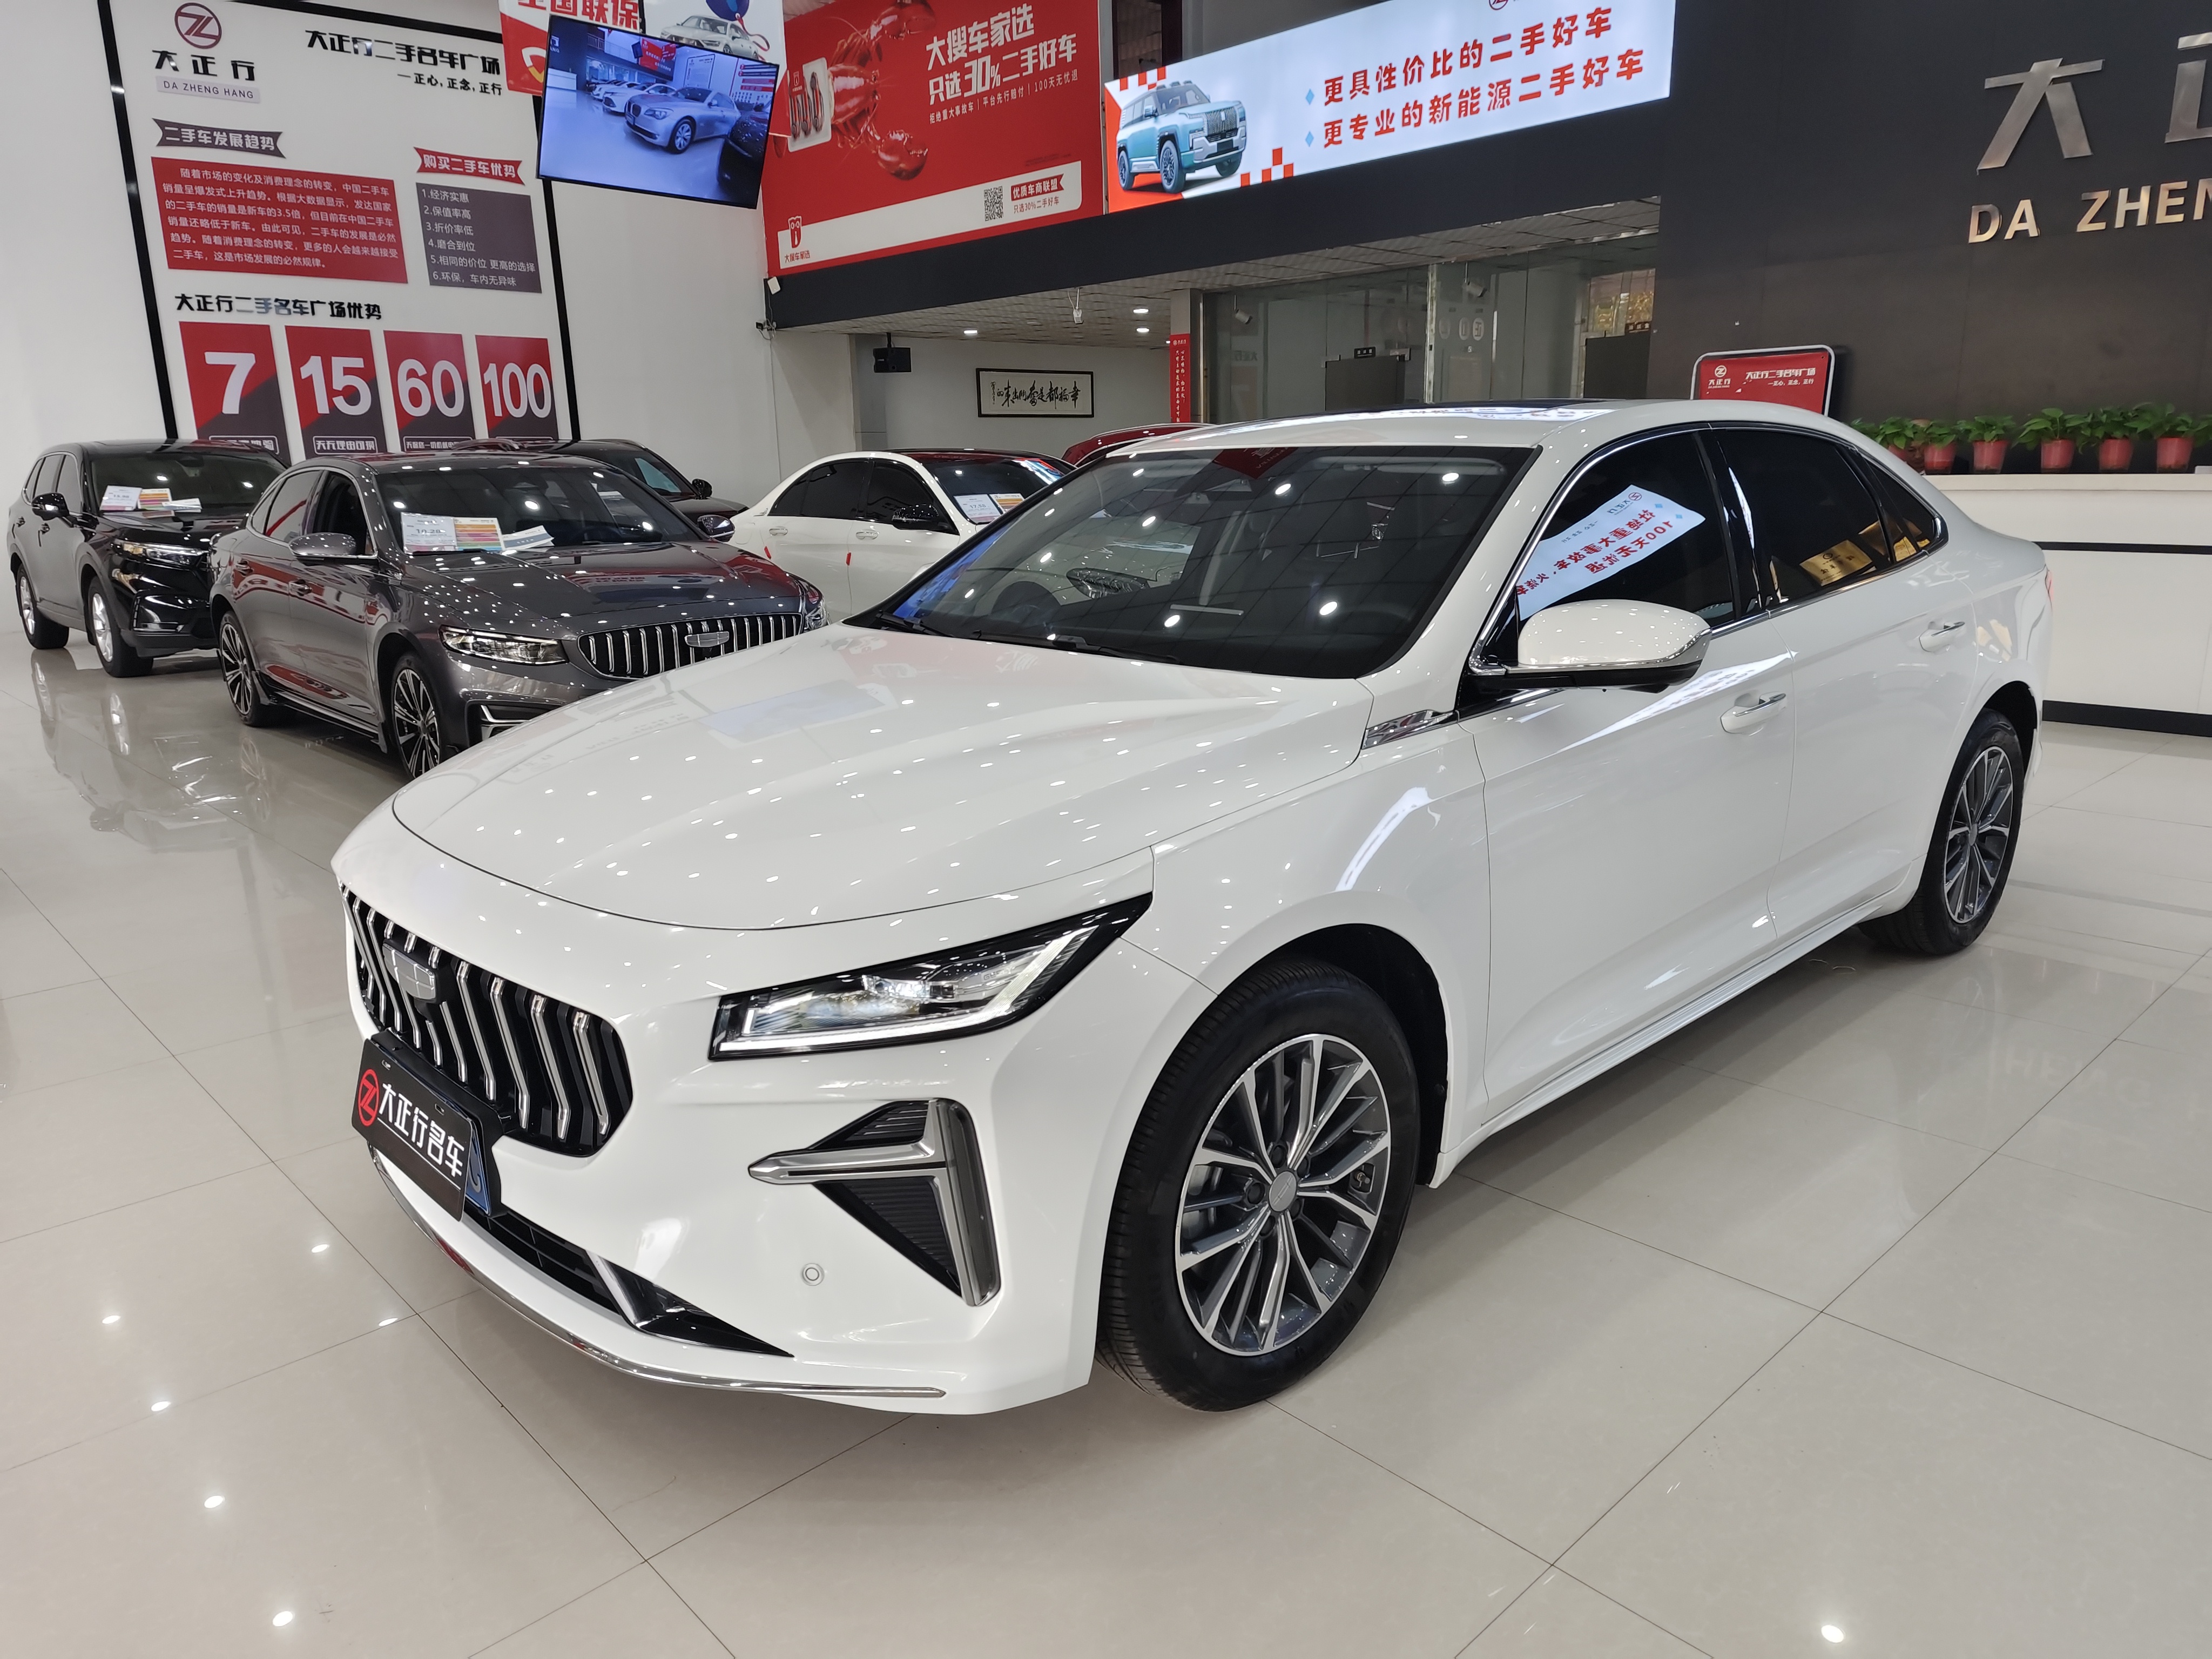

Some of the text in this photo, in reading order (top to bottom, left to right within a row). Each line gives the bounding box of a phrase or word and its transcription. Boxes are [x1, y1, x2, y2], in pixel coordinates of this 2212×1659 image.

[926, 3, 1035, 71] 大搜车家选
[152, 50, 255, 81] 大正行
[929, 33, 1077, 105] 只选30%二手好车
[1324, 6, 1612, 107] 更具性价比的二手好车
[164, 80, 254, 99] DA ZHENG HANG
[1323, 48, 1644, 149] 更专业的新能源二手好车
[164, 126, 275, 151] 二手车发展趋势
[423, 154, 516, 178] 购买二手车优势
[422, 188, 469, 203] 1.经济实惠
[1013, 178, 1058, 199] 优质车商联盟
[423, 205, 471, 220] 2.保值率高
[1014, 196, 1060, 214] 只选30%二手好车
[426, 222, 474, 236] 3.折价率低
[1968, 199, 2041, 244] DA
[428, 239, 476, 252] 4.磨合到位
[174, 293, 382, 320] 大正行二手名车广场优势
[204, 352, 256, 414] 7
[300, 355, 372, 415] 15
[397, 359, 464, 417] 60
[483, 362, 551, 418] 100
[379, 1083, 466, 1178] 大正行名车
